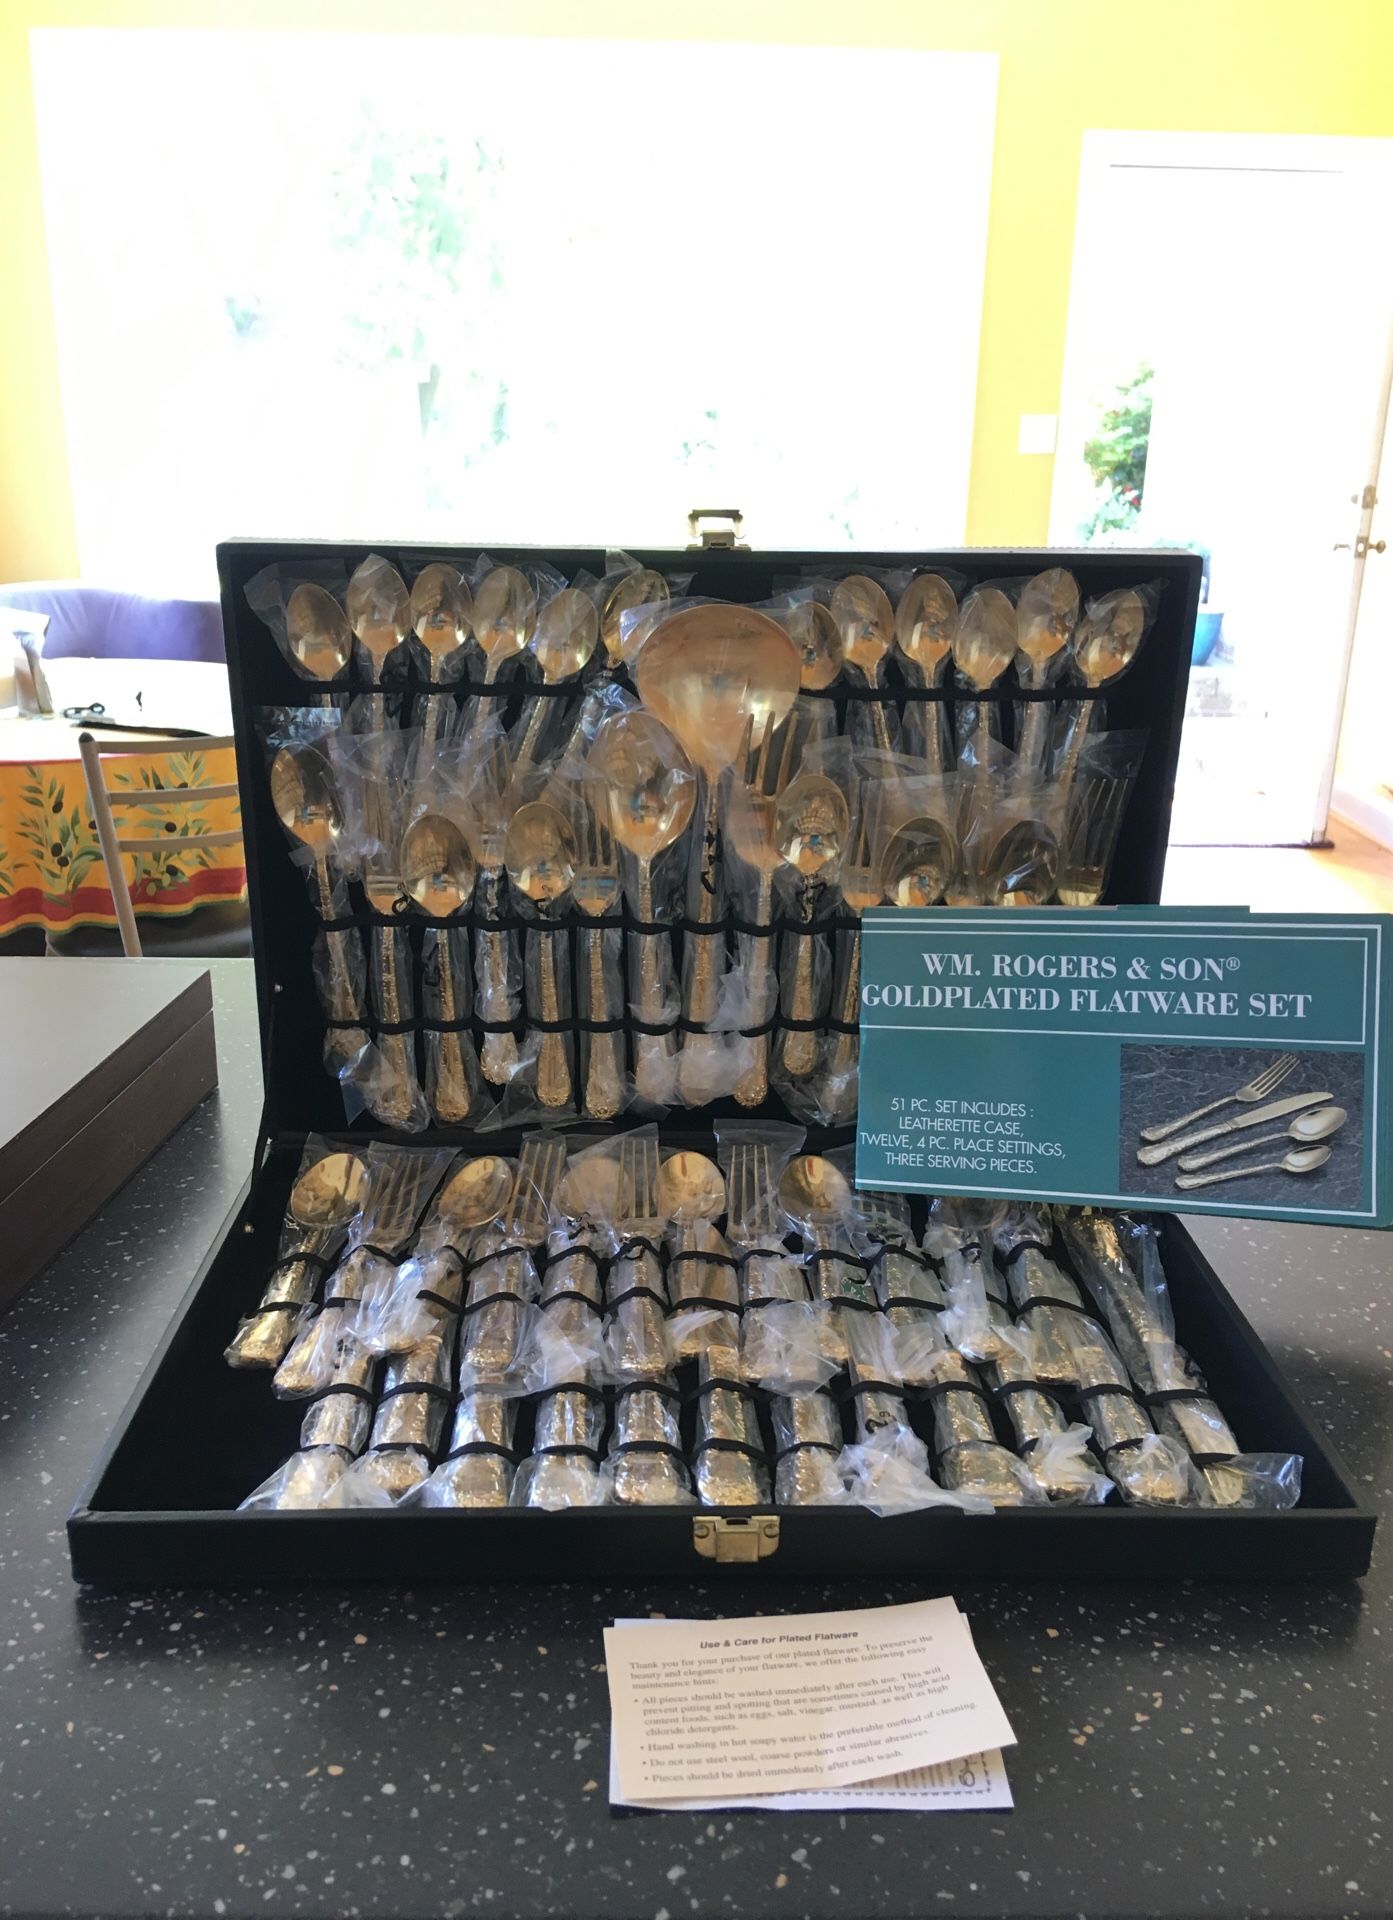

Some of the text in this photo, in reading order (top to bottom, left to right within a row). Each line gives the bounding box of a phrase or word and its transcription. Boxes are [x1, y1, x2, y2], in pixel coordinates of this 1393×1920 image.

[921, 953, 981, 975] WM.
[991, 954, 1117, 979] ROGERS
[1126, 956, 1151, 980] &
[861, 983, 1313, 1018] GOLDPLATED FLATWARE SET
[890, 1097, 905, 1111] 51
[911, 1098, 931, 1112] PC.
[935, 1099, 957, 1114] SET
[961, 1100, 1026, 1117] INCLUDES
[899, 1116, 1025, 1138] LEATHERETTE CASE,
[860, 1131, 1066, 1159] TWELVE, 4 PC. PLACE SETTINGS,
[885, 1151, 1038, 1174] THREE SERVING PIECES.
[630, 1661, 659, 1669] Thank
[661, 1661, 679, 1669] you
[681, 1658, 694, 1666] for
[697, 1658, 718, 1667] your
[721, 1654, 760, 1665] purchase
[763, 1652, 773, 1660] of
[775, 1651, 790, 1659] our
[793, 1649, 821, 1659] plated
[864, 1643, 878, 1652] To
[880, 1639, 917, 1651] preserve
[919, 1634, 934, 1642] the
[700, 1631, 859, 1649] Use & Care for Plated Flatware
[630, 1672, 661, 1681] beauty
[664, 1669, 681, 1678] and
[683, 1667, 724, 1677] elegance
[726, 1665, 736, 1673] of
[738, 1664, 759, 1674] your
[820, 1657, 842, 1666] offer
[844, 1656, 858, 1664] the
[860, 1650, 905, 1662] following
[906, 1646, 927, 1655] easy
[632, 1680, 690, 1690] maintenance
[642, 1696, 656, 1705] All
[659, 1695, 689, 1706] pieces
[691, 1692, 722, 1702] should
[724, 1690, 736, 1699] be
[738, 1688, 773, 1698] washed
[775, 1684, 831, 1695] immediately
[834, 1681, 855, 1691] after
[857, 1678, 879, 1688] each
[901, 1672, 921, 1682] This
[924, 1666, 942, 1676] will
[643, 1673, 951, 1716] prevent pitting and spotting that are sometimes caused by high acid
[644, 1716, 679, 1726] content
[682, 1714, 711, 1724] foods,
[714, 1711, 735, 1721] such
[738, 1712, 748, 1720] as
[750, 1710, 774, 1720] eggs,
[777, 1707, 797, 1717] salt,
[799, 1704, 836, 1716] vinegar,
[839, 1699, 878, 1711] mustard,
[882, 1696, 891, 1704] as
[894, 1692, 913, 1702] well
[928, 1684, 949, 1695] high
[645, 1723, 739, 1737] chloride detergents.
[648, 1702, 977, 1752] Hand washing in hot soapy water is the preferable method of cleaning.
[650, 1758, 665, 1768] Do
[668, 1757, 683, 1766] not
[686, 1757, 702, 1765] use
[705, 1755, 728, 1764] steel
[730, 1753, 758, 1763] wool,
[760, 1752, 791, 1761] coarse
[793, 1747, 834, 1760] powders
[836, 1744, 846, 1752] or
[849, 1738, 882, 1750] similar
[652, 1750, 904, 1783] Pieces should be dried immediately after each wash.
